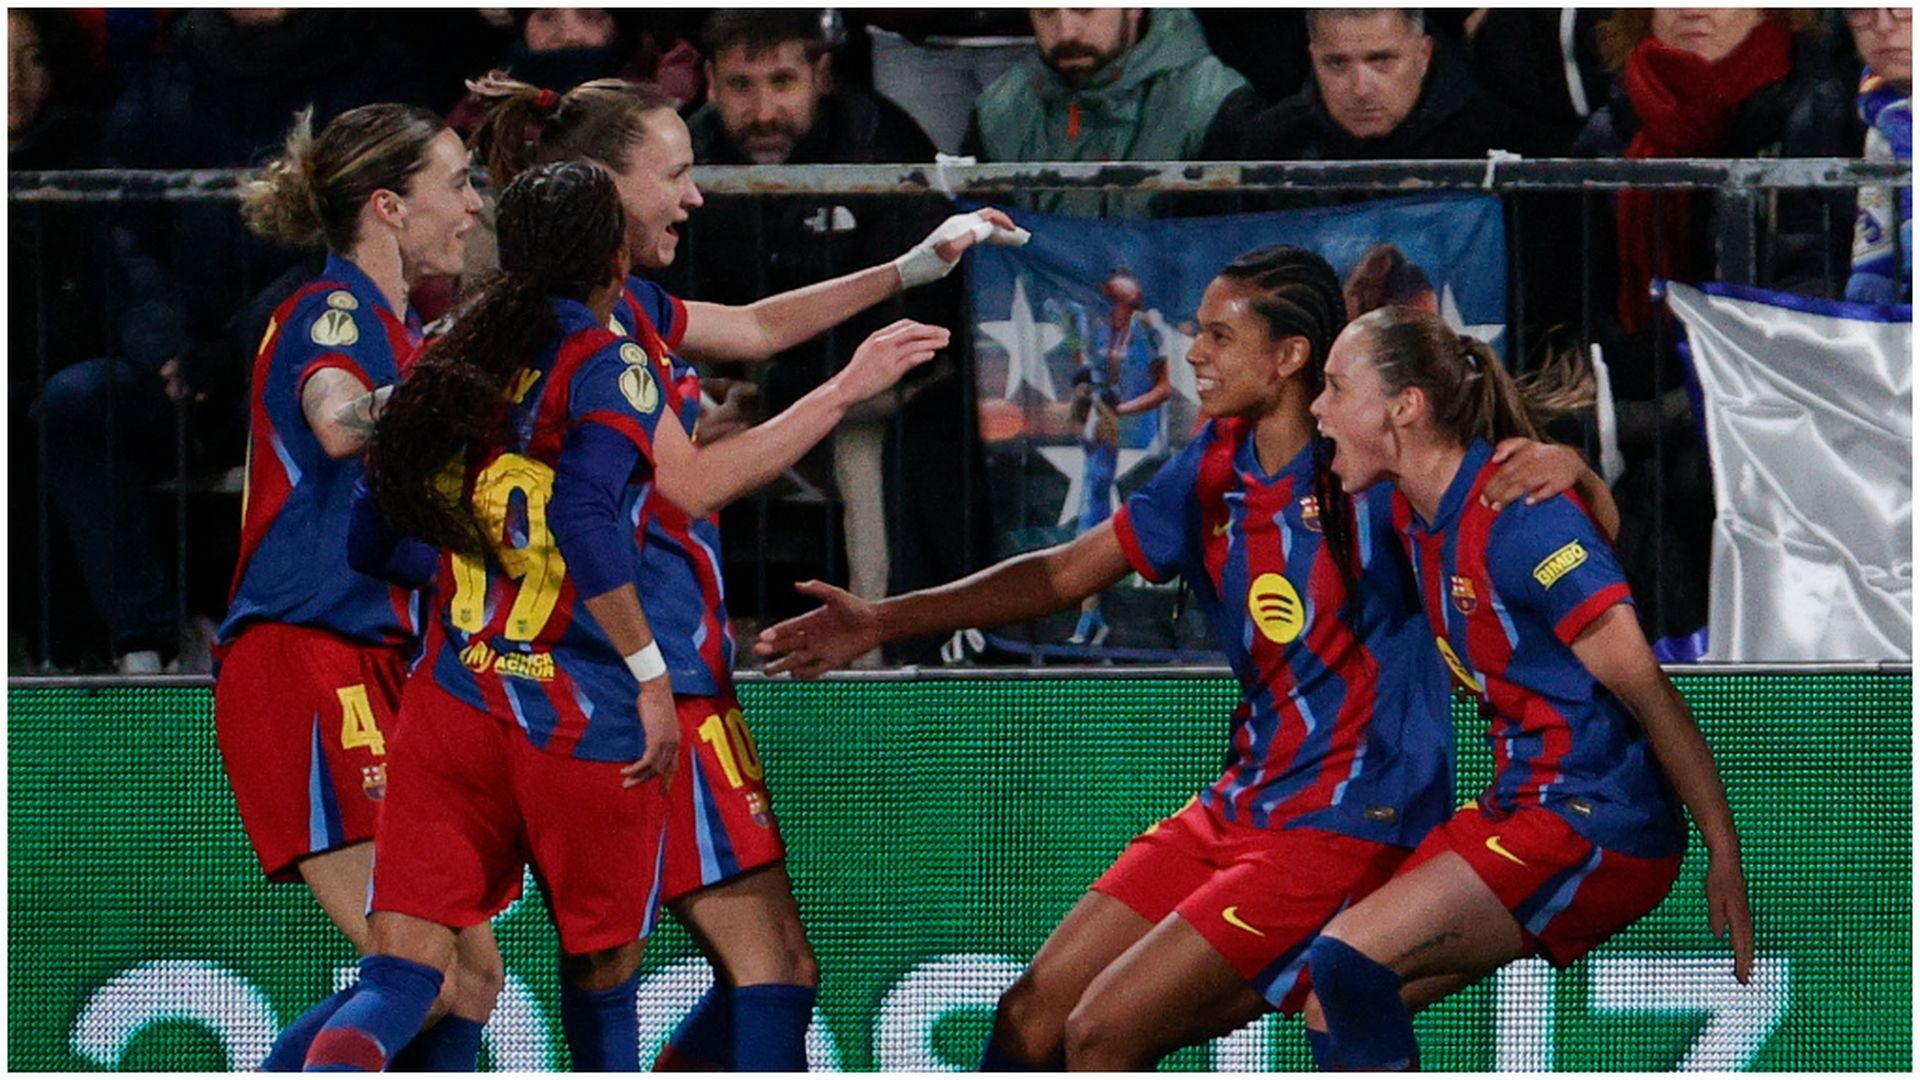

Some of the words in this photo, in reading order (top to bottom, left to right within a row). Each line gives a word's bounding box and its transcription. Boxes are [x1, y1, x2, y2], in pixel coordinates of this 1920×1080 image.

[436, 453, 567, 641] 19
[1534, 542, 1587, 588] BIMBO
[336, 683, 386, 755] 4
[697, 708, 763, 788] 10
